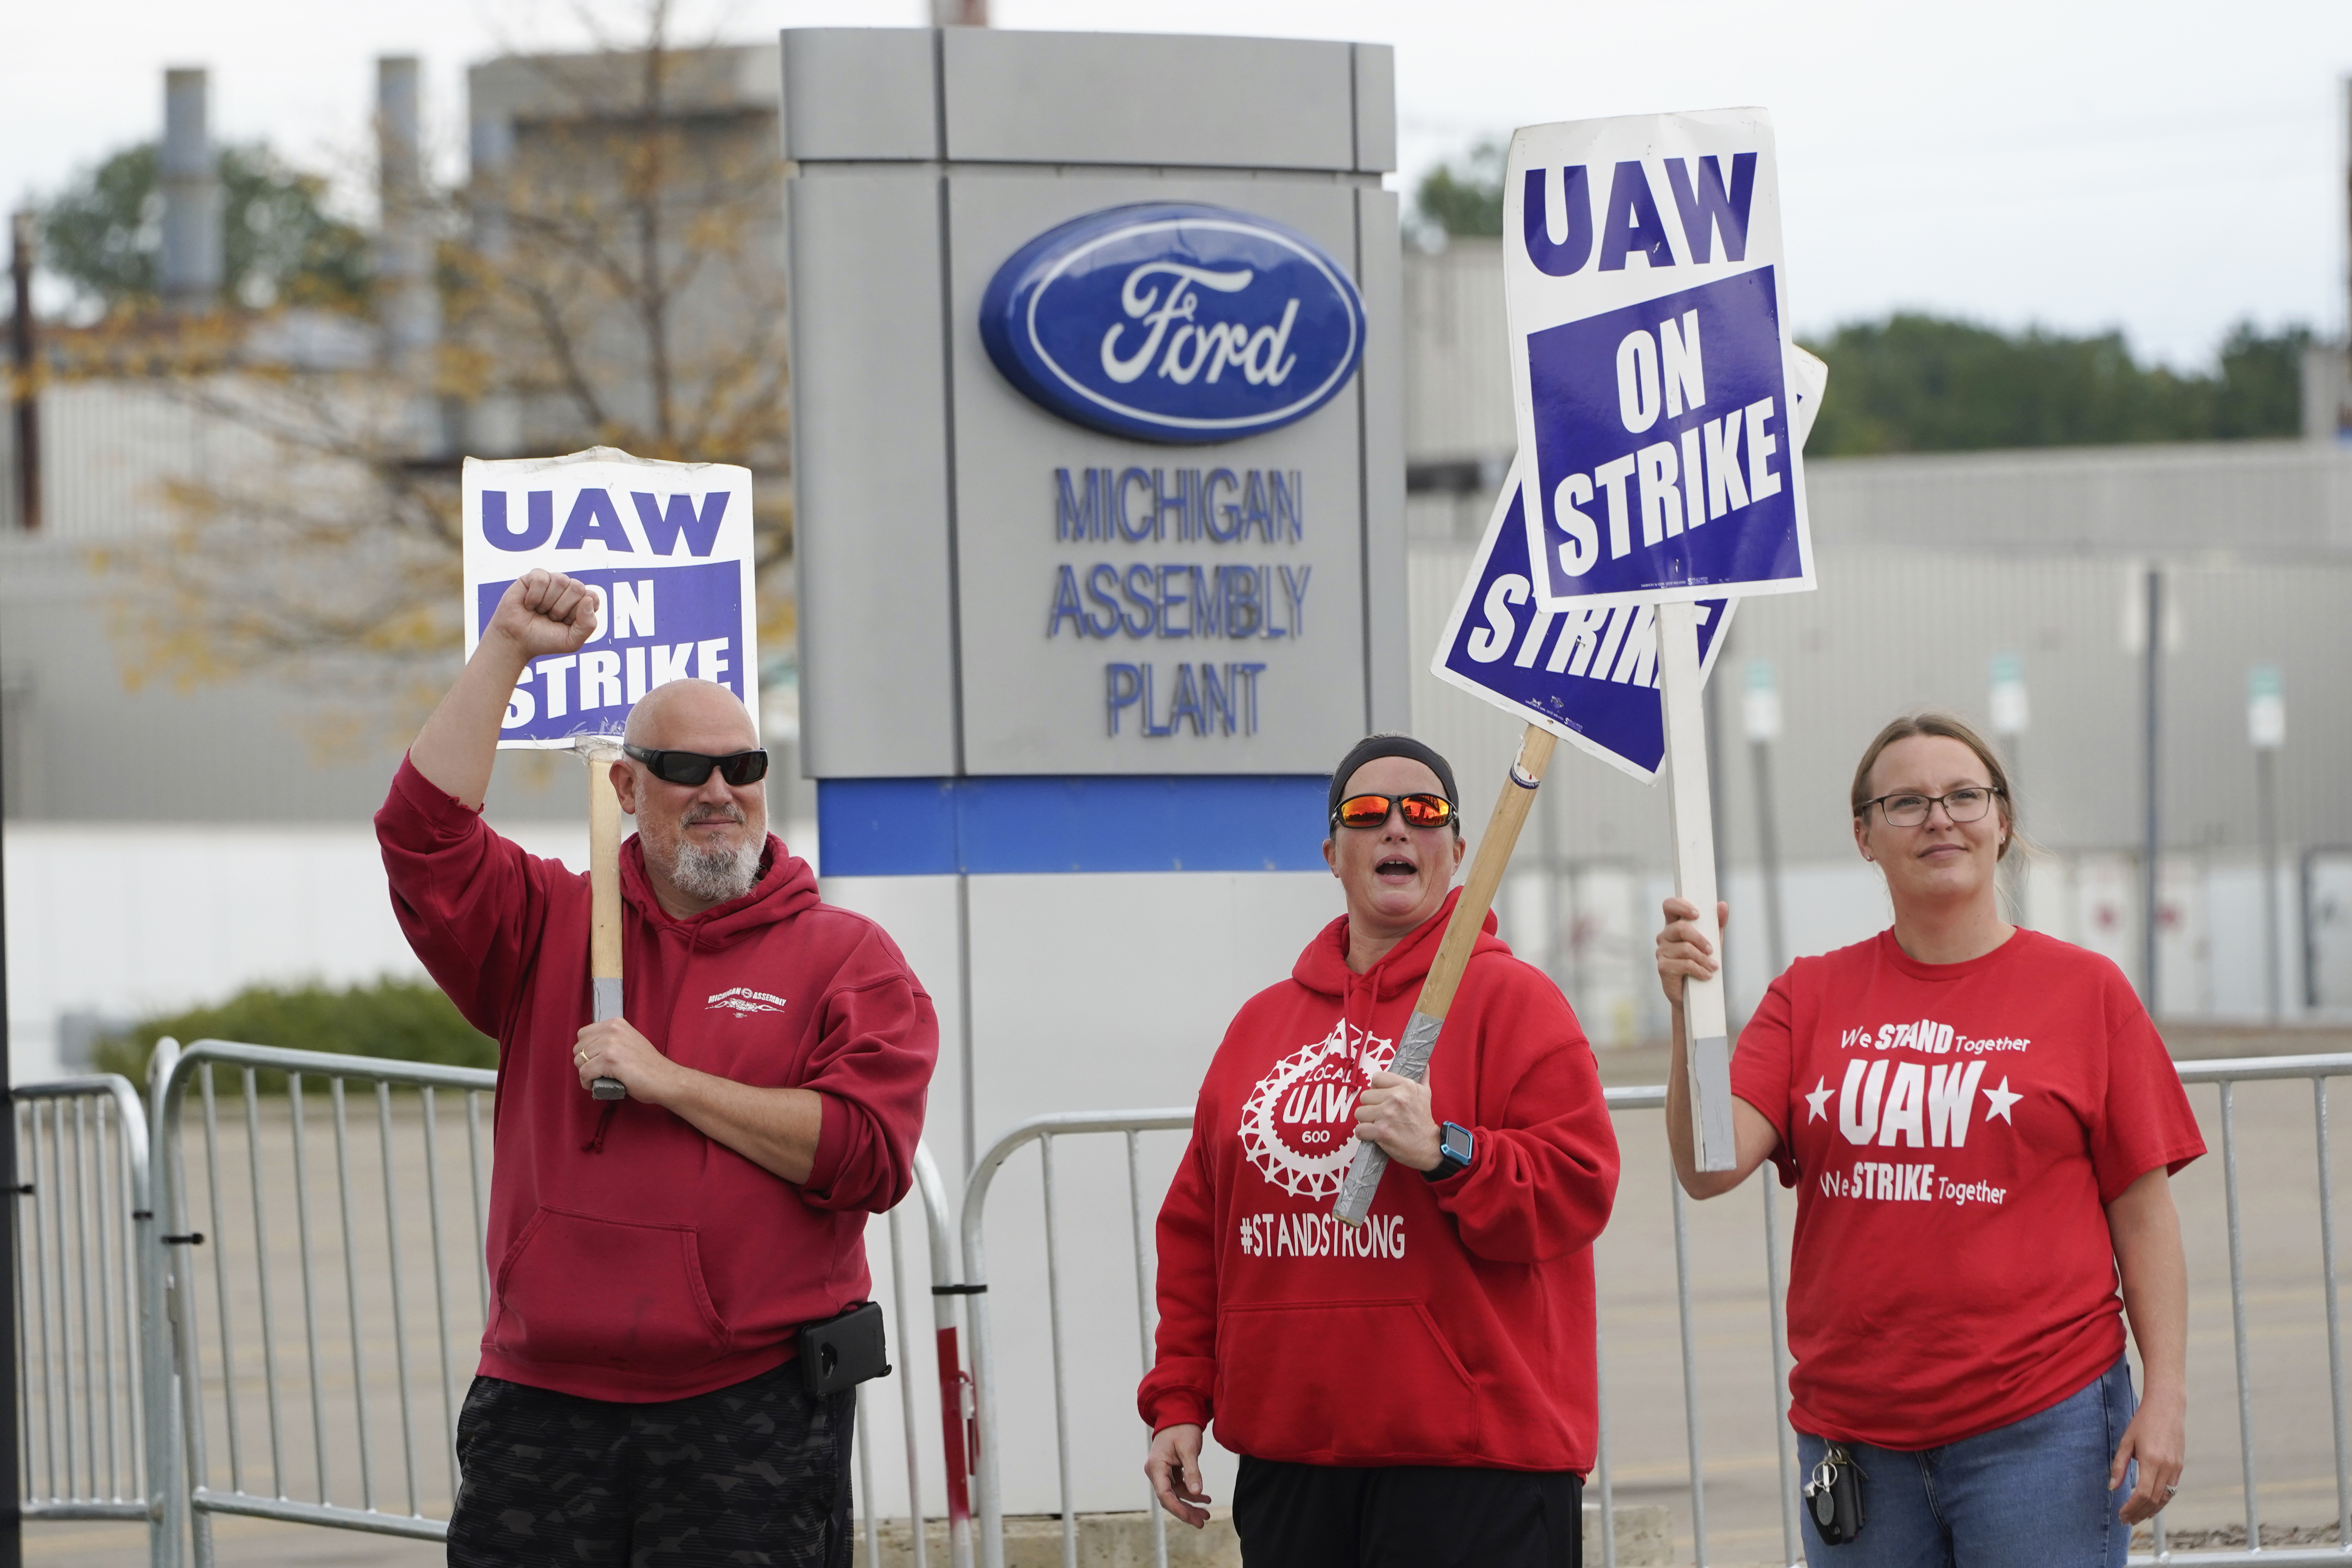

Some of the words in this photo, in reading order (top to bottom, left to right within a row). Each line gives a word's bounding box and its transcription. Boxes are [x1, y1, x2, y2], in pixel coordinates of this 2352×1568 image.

[1524, 152, 1757, 277] UAW
[1101, 261, 1299, 387] Ford
[1616, 309, 1706, 434] ON
[482, 488, 731, 557] UAW
[1054, 467, 1303, 543] MICHIGAN
[1554, 396, 1782, 577] STRIKE
[1046, 564, 1312, 639] ASSEMBLY
[500, 637, 731, 729] STRIKE
[1105, 663, 1267, 738] PLANT
[708, 987, 742, 1004] MICHIGAN
[752, 991, 787, 1007] ASSEMBLY
[1305, 1063, 1352, 1083] LOCAL
[1841, 1026, 1872, 1049] We
[1874, 1019, 1954, 1054] STAND
[1955, 1035, 2031, 1055] Together
[1283, 1083, 1362, 1124] UAW
[1301, 1130, 1330, 1143] 600
[1839, 1058, 1987, 1148] UAW
[1820, 1170, 1849, 1198] We
[1851, 1161, 1935, 1201] STRIKE
[1938, 1176, 2007, 1206] Together
[1240, 1213, 1405, 1259] #STANDSTRONG
